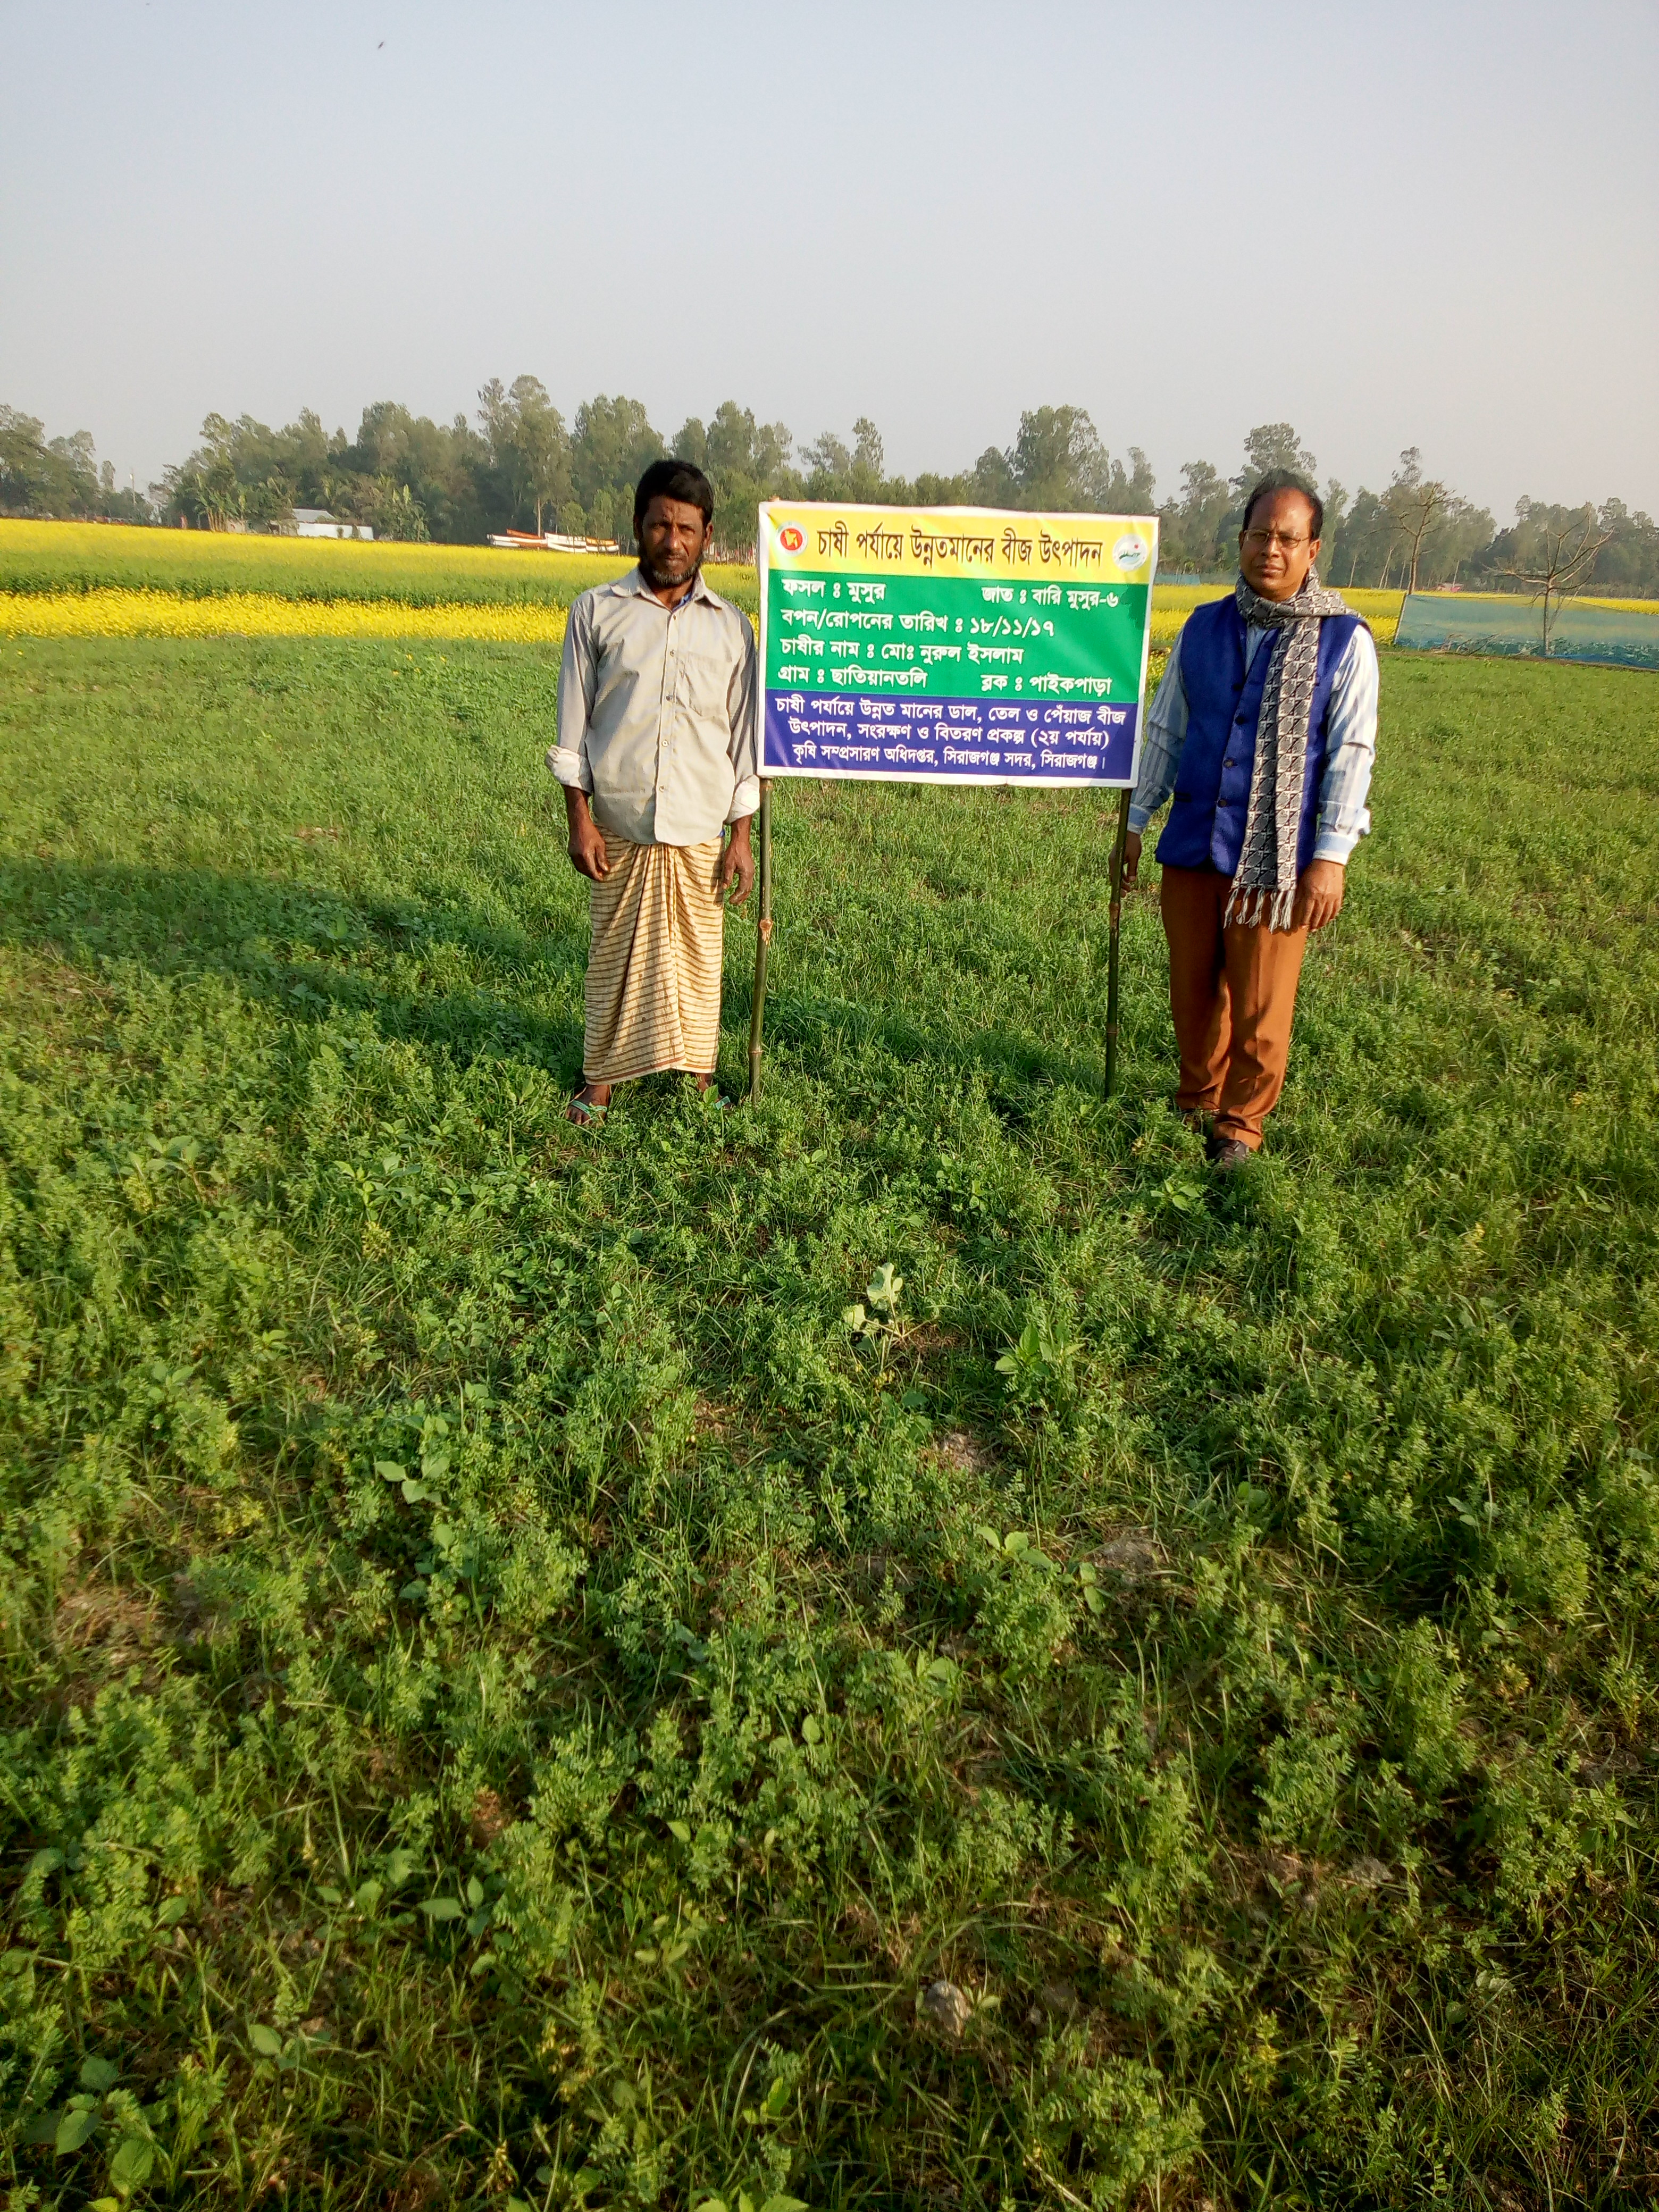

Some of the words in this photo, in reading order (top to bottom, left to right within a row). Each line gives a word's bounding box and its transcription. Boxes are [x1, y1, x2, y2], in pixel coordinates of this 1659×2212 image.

[817, 520, 849, 558] চাষী
[856, 521, 904, 559] পর্যায়ে
[910, 524, 995, 569] উন্নতমানের
[1001, 526, 1033, 566] বীজ
[1038, 529, 1103, 567] উৎপাদন
[782, 578, 825, 597] ফসল
[847, 582, 886, 604] মুসুর
[981, 585, 1014, 604] জাত
[1031, 584, 1062, 606] বারি
[1067, 590, 1119, 611] মুসুর-৬
[780, 608, 894, 631] বপন/রোপনের
[899, 610, 949, 633] তারিখ
[970, 615, 1054, 638] ১৮/১১/১৭
[780, 633, 825, 657] চাষীর
[830, 640, 860, 658] নাম
[881, 642, 914, 660] মোঃ
[919, 644, 962, 665] নুরুল
[967, 641, 1024, 665] ইসলাম
[777, 665, 810, 683] গ্রাম
[830, 664, 928, 688] ছাতিয়ানতলি
[981, 674, 1008, 692] ব্লক
[1029, 672, 1113, 697] পাইকপাড়া
[775, 693, 805, 714] চাষী
[810, 696, 855, 716] পর্যায়ে
[859, 697, 895, 720] উন্নত
[900, 702, 943, 719] মানের
[948, 705, 982, 724] ডাল,
[988, 707, 1020, 722] তেল
[1026, 709, 1038, 722] ও
[1044, 704, 1092, 725] পেঁয়াজ
[1096, 706, 1126, 725] বীজ
[788, 717, 851, 740] উৎপাদন,
[857, 723, 912, 740] সংরক্ষণ
[917, 726, 929, 740] ও
[934, 722, 983, 742] বিতরণ
[986, 727, 1025, 744] প্রকল্প
[1030, 727, 1060, 748] (২য়
[1065, 727, 1110, 750] পর্যায়)
[792, 740, 817, 764] কৃষি
[821, 745, 881, 763] সম্প্রসারণ
[884, 744, 939, 767] অধিদপ্তর,
[943, 745, 1001, 767] সিরাজগঞ্জ
[1004, 752, 1036, 770] সদর,
